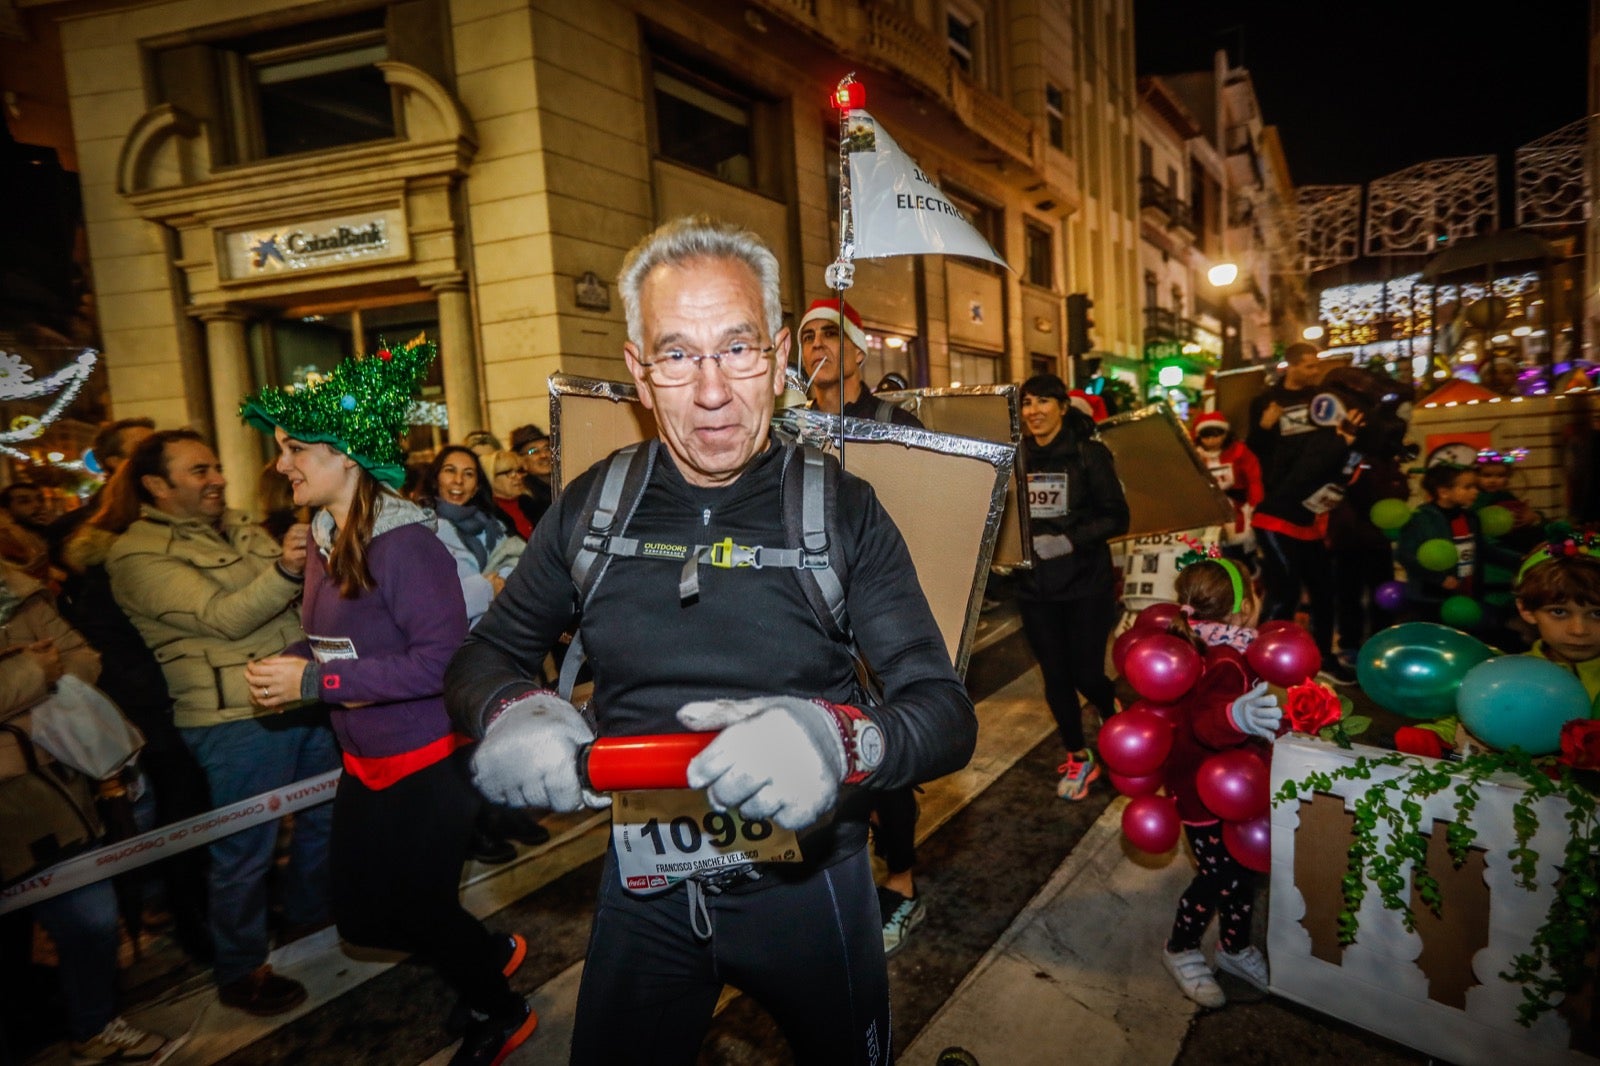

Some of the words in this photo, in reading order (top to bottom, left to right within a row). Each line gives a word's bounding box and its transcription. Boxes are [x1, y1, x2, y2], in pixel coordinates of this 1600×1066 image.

[287, 222, 383, 254] CaixaBank
[644, 543, 687, 552] OUTDOORS
[169, 829, 189, 841] de
[640, 811, 773, 856] 1098
[656, 862, 693, 873] FRANCISCO
[693, 856, 725, 869] SANCHEZ
[726, 850, 759, 864] VELASCO
